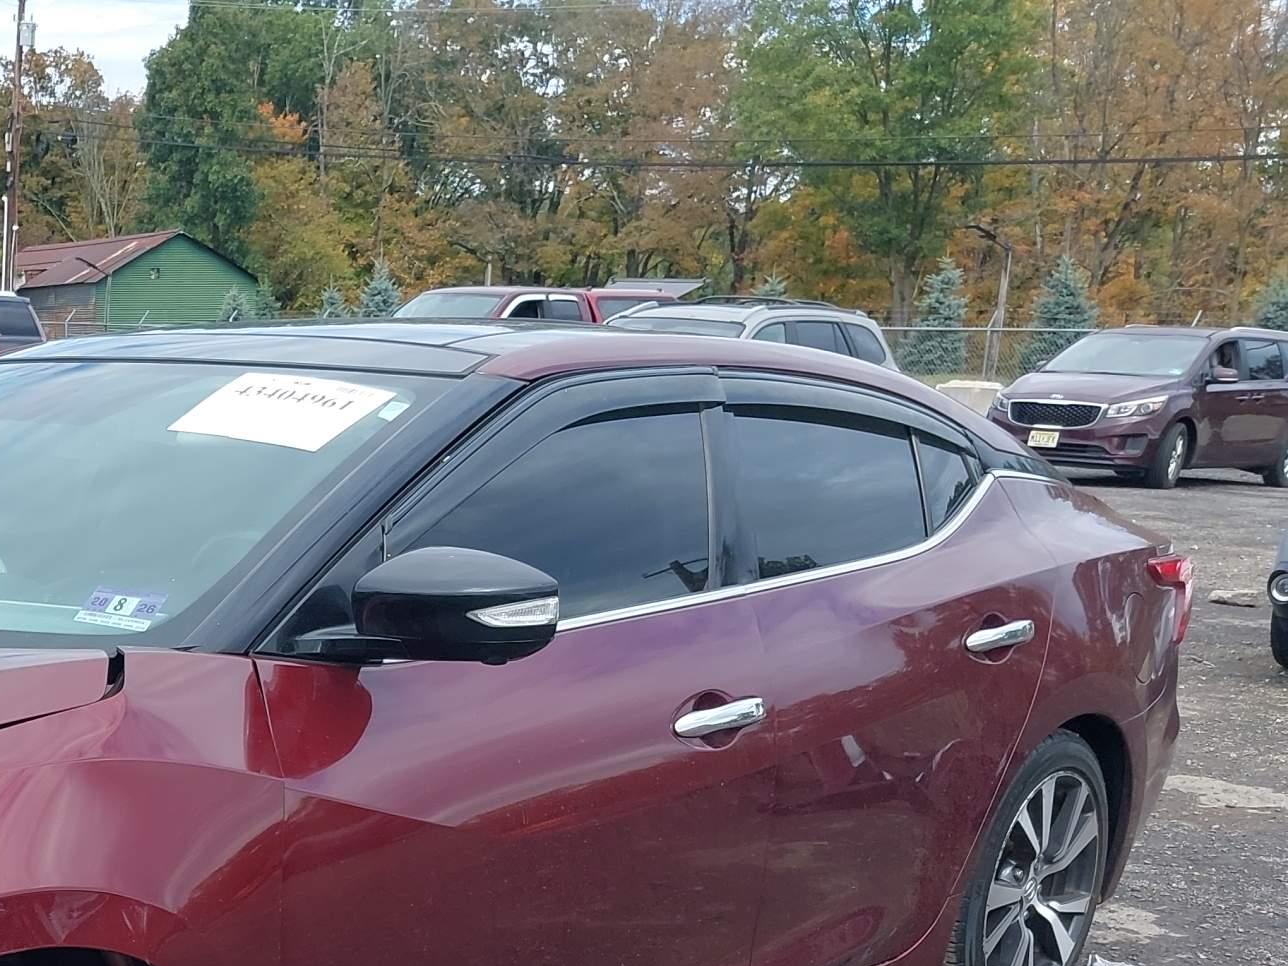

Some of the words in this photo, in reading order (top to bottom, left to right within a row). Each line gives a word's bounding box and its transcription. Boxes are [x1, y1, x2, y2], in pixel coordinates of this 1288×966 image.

[234, 384, 356, 411] 43404961
[90, 596, 109, 607] 20
[112, 597, 128, 612] 8
[136, 603, 157, 614] 26
